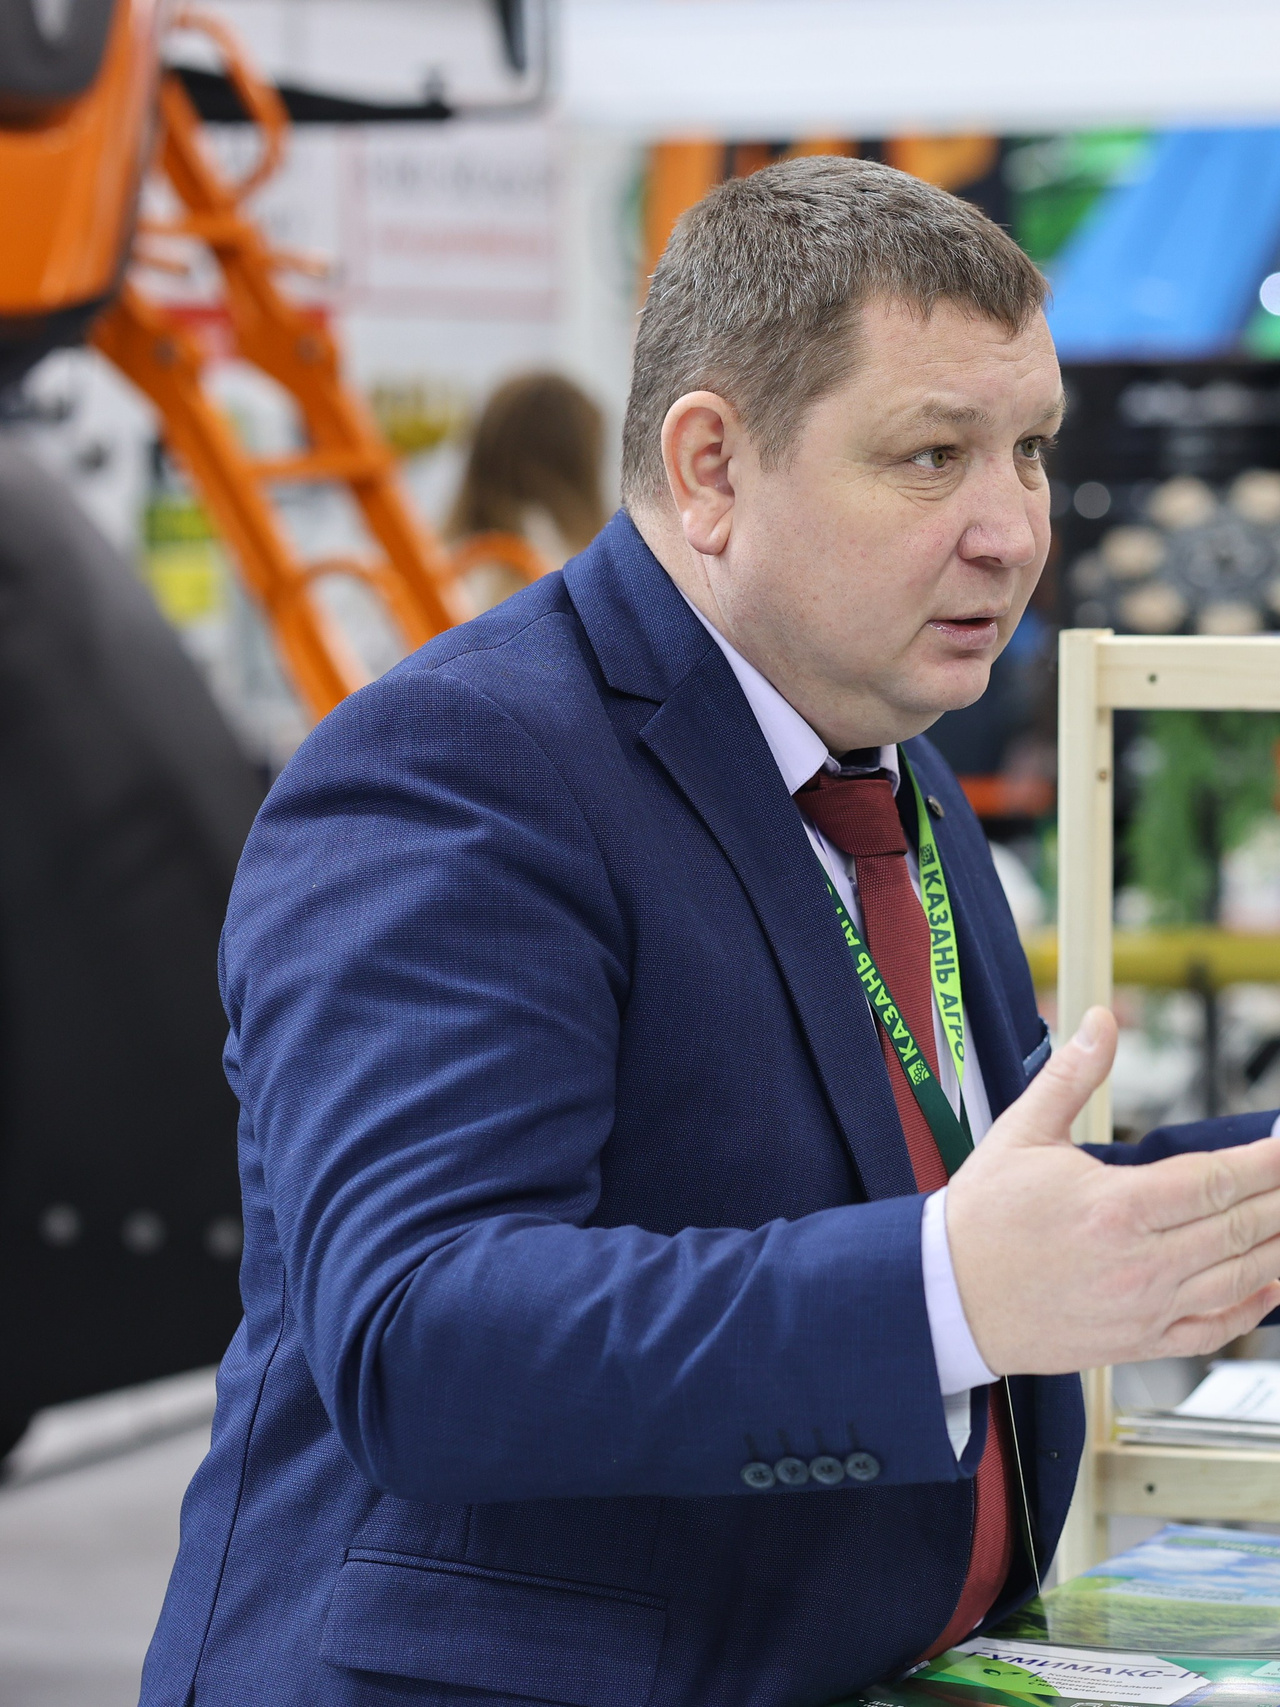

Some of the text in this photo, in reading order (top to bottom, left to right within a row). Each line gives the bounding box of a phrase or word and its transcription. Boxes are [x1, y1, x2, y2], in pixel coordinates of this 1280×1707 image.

[856, 952, 919, 1063] КАЗАНЬ
[923, 869, 965, 1062] КАЗАНЬ АГРО
